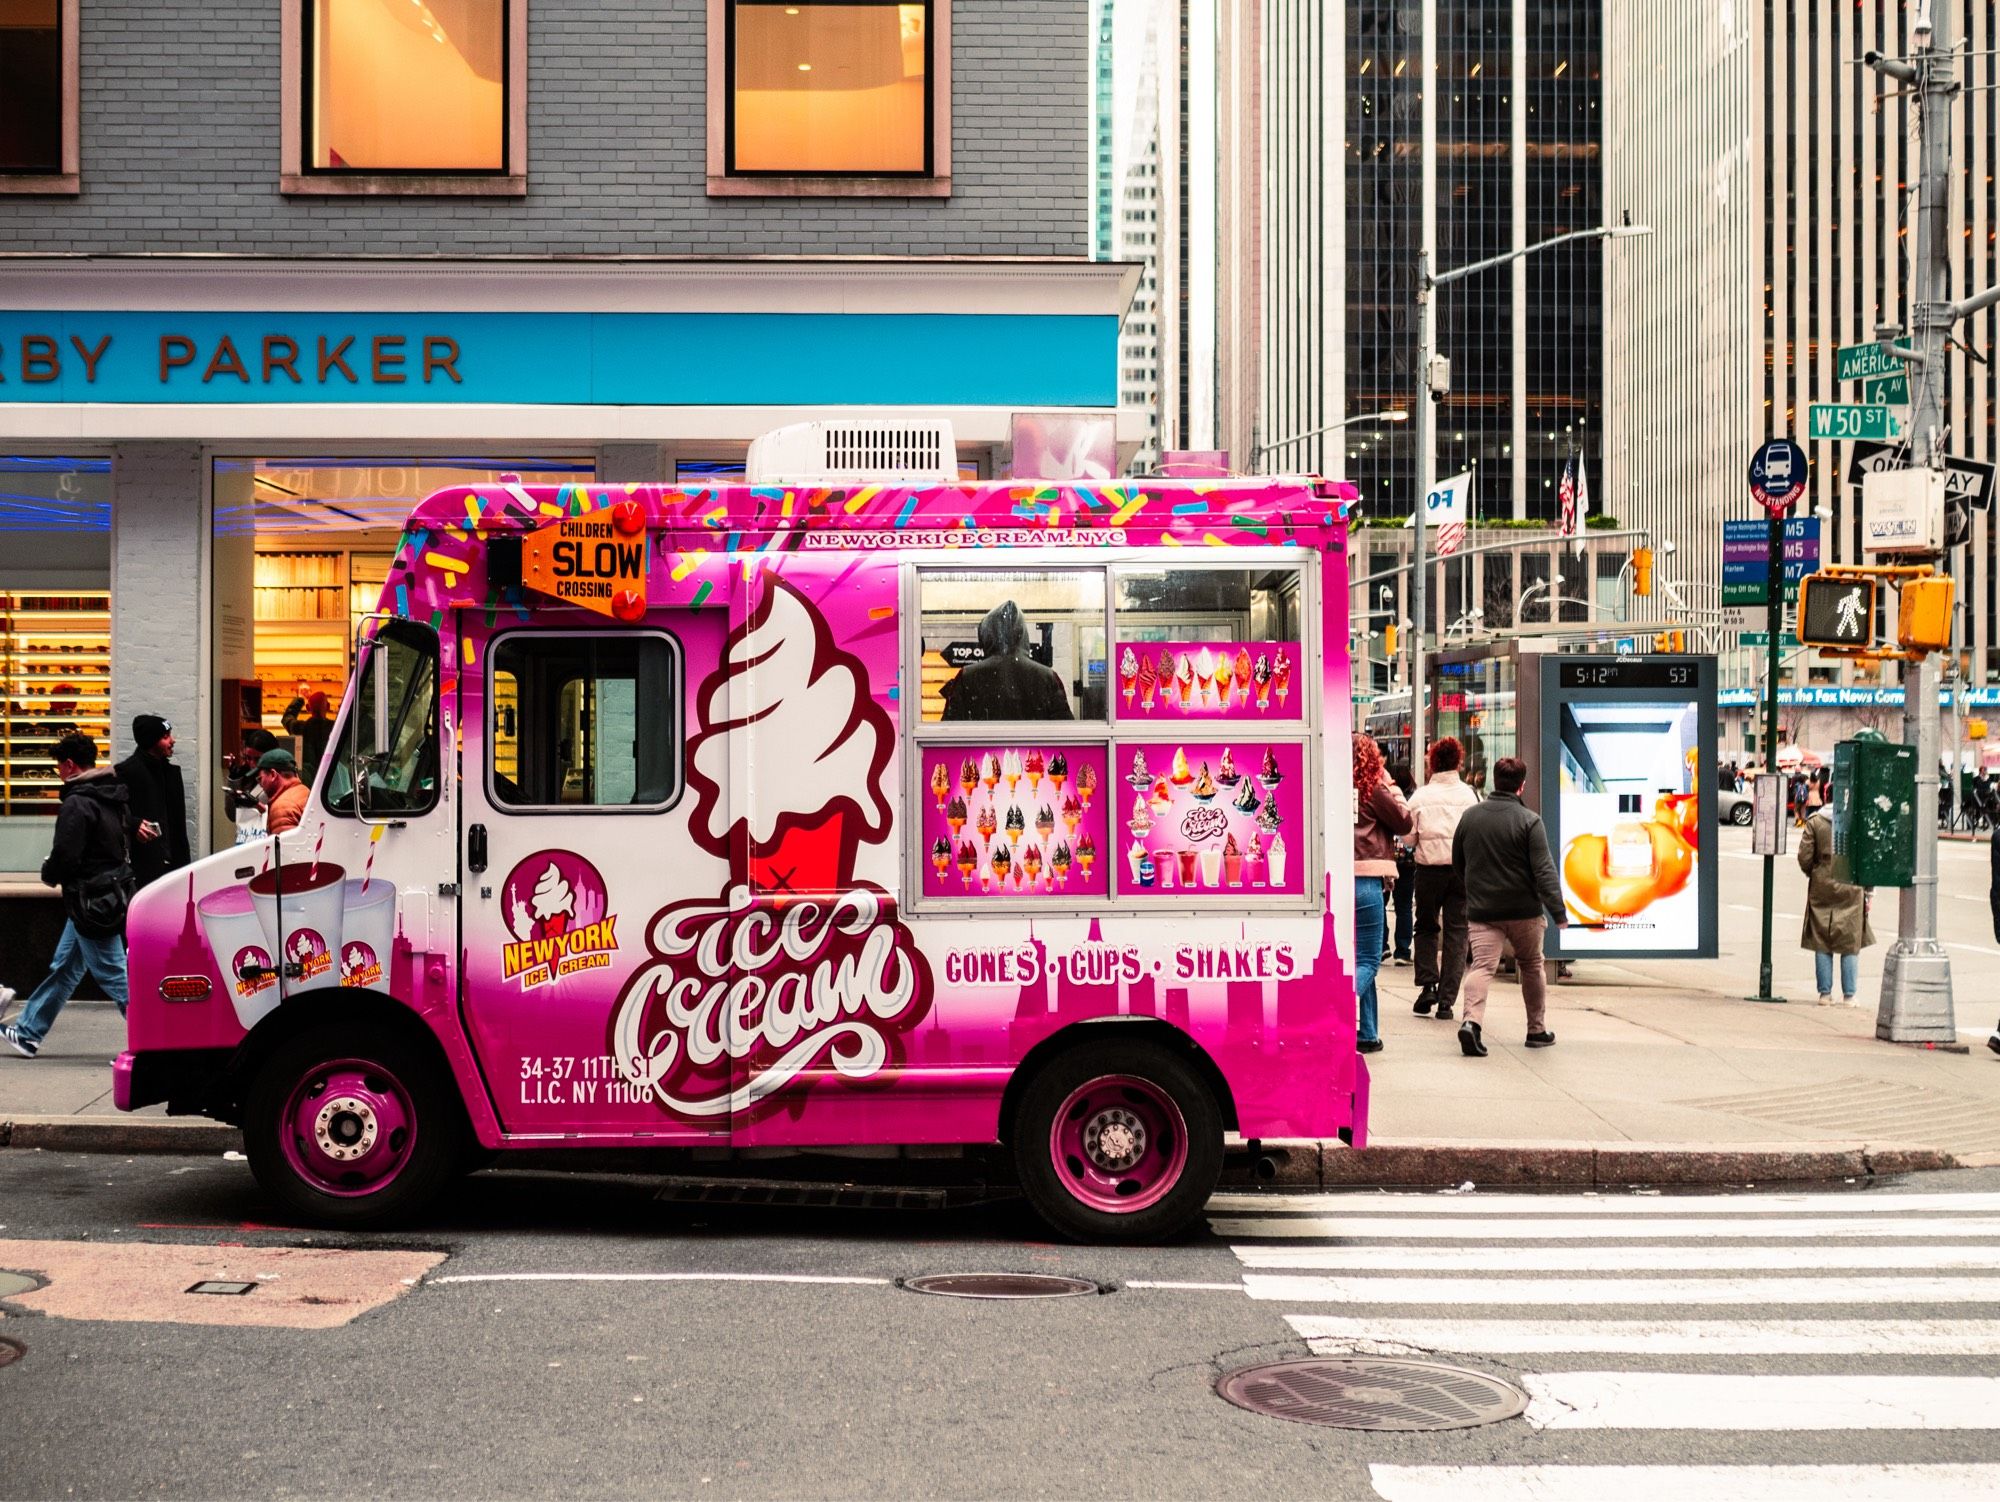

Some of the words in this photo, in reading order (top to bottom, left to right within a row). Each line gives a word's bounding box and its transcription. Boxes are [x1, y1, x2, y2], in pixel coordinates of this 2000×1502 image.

[0, 335, 112, 383] BY
[159, 335, 462, 383] PARKER
[1855, 346, 1868, 356] AVE
[1870, 345, 1879, 355] OF
[1875, 381, 1887, 405] 6
[1890, 378, 1903, 393] AV
[1816, 407, 1833, 436] W
[1836, 407, 1862, 437] 50
[1865, 409, 1884, 424] ST
[1873, 456, 1911, 473] ON
[1945, 472, 1974, 492] AY
[1754, 488, 1766, 502] NO
[1765, 484, 1801, 506] STANDING
[560, 522, 613, 538] CHILDREN
[1785, 521, 1804, 537] M5
[807, 531, 1126, 547] NEWYORKICECREAM.NYC
[1784, 542, 1804, 558] M5
[552, 541, 643, 579] SLOW
[1724, 565, 1745, 573] Harlem
[1784, 563, 1804, 579] M7
[556, 581, 613, 598] CROSSING
[1724, 586, 1737, 595] Drop
[1738, 585, 1747, 593] Off
[1747, 585, 1761, 594] Only
[952, 647, 972, 658] TOP
[1816, 689, 1838, 704] Fox
[1840, 689, 1873, 704] News
[653, 884, 879, 977] Ice
[524, 967, 548, 988] ICE
[558, 953, 610, 976] CREAM
[945, 945, 1037, 984] CONES
[1070, 943, 1141, 982] CUPS
[1176, 942, 1295, 981] SHAKES
[614, 922, 914, 1117] Cream
[520, 1056, 575, 1079] 34-37
[582, 1056, 624, 1079] 11TH
[631, 1055, 654, 1079] ST
[520, 1080, 566, 1104] L.I.C.
[573, 1080, 598, 1104] NY
[605, 1080, 654, 1104] 11106
